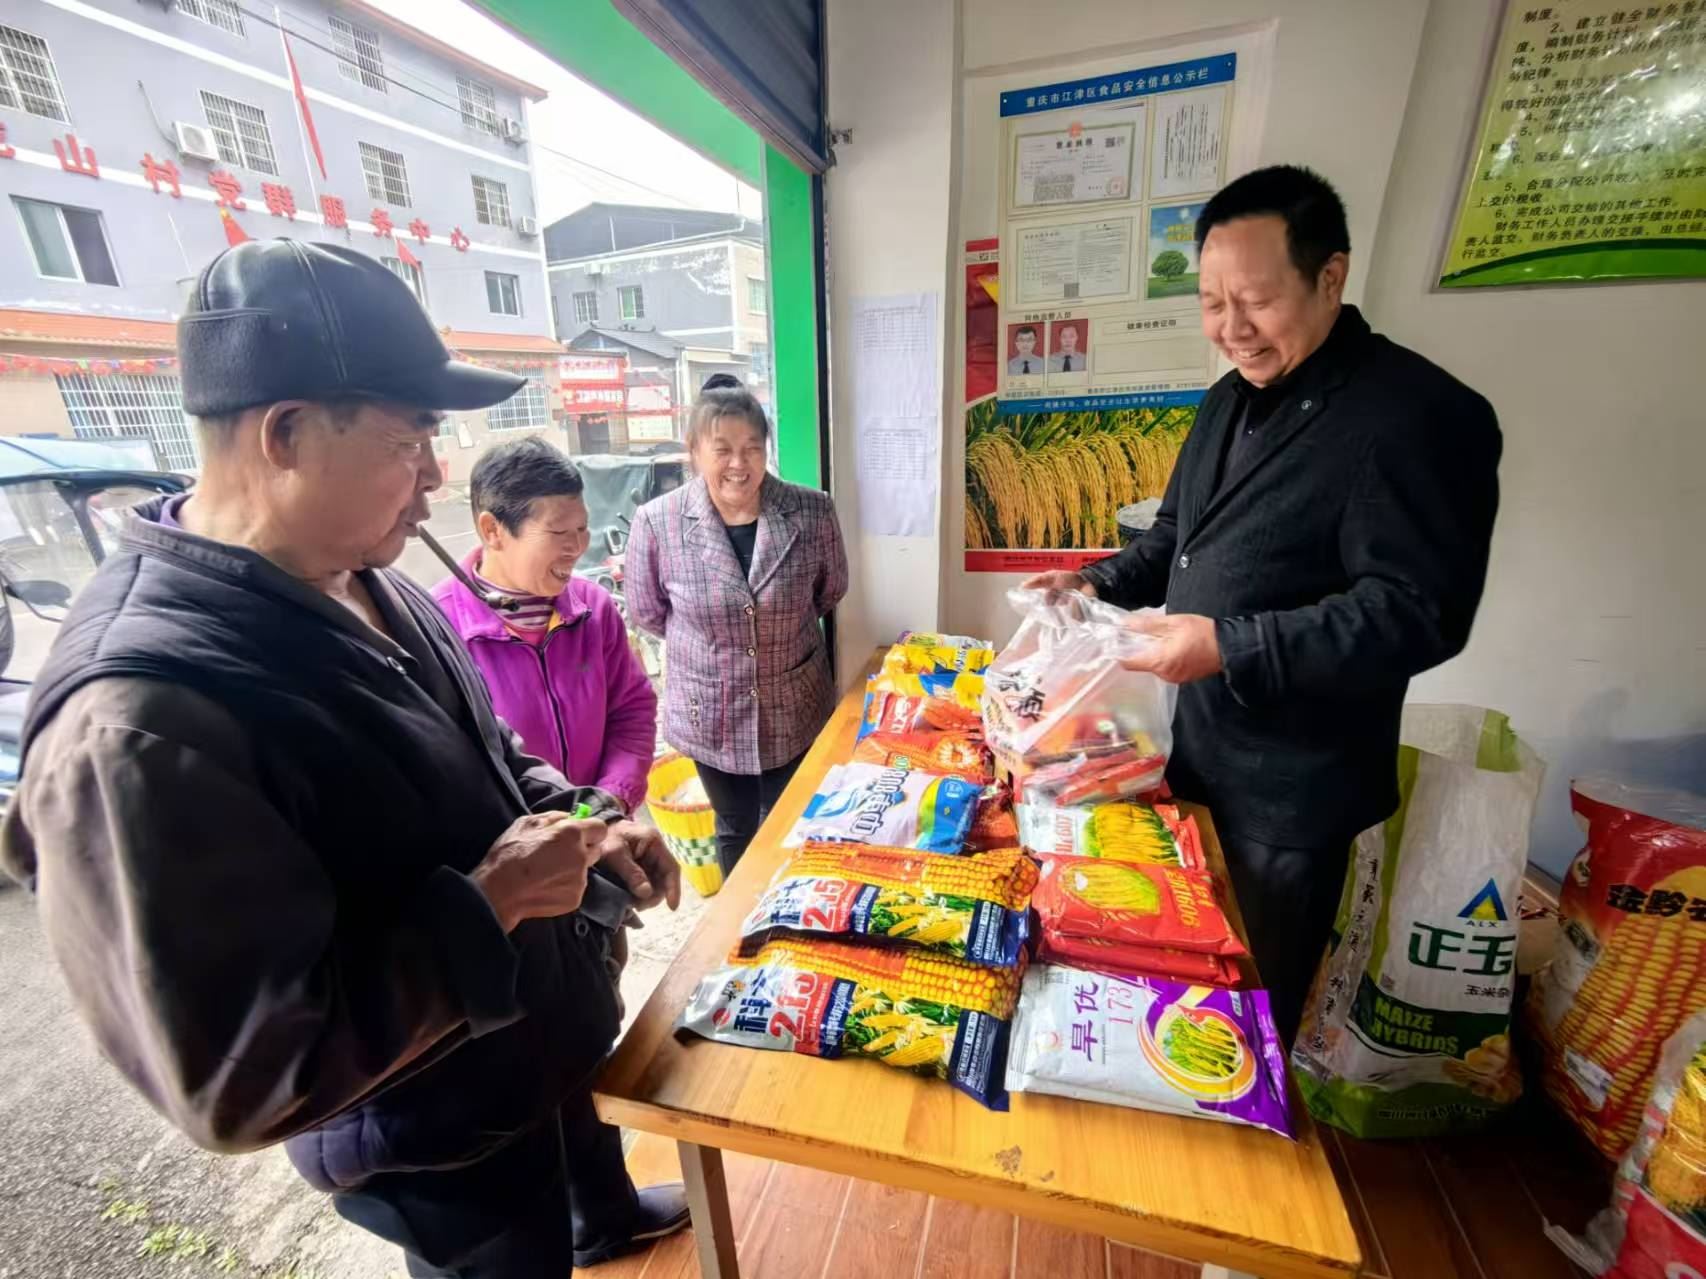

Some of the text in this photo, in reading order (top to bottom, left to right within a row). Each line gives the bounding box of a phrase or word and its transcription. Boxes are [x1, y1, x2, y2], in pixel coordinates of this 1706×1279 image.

[1025, 67, 1210, 108] 重庆市江津区食品安全信息公示栏
[1408, 920, 1516, 976] 正玉
[1071, 982, 1100, 1063] 旱优
[1107, 984, 1134, 1026] 173
[1374, 998, 1434, 1031] MAIZE
